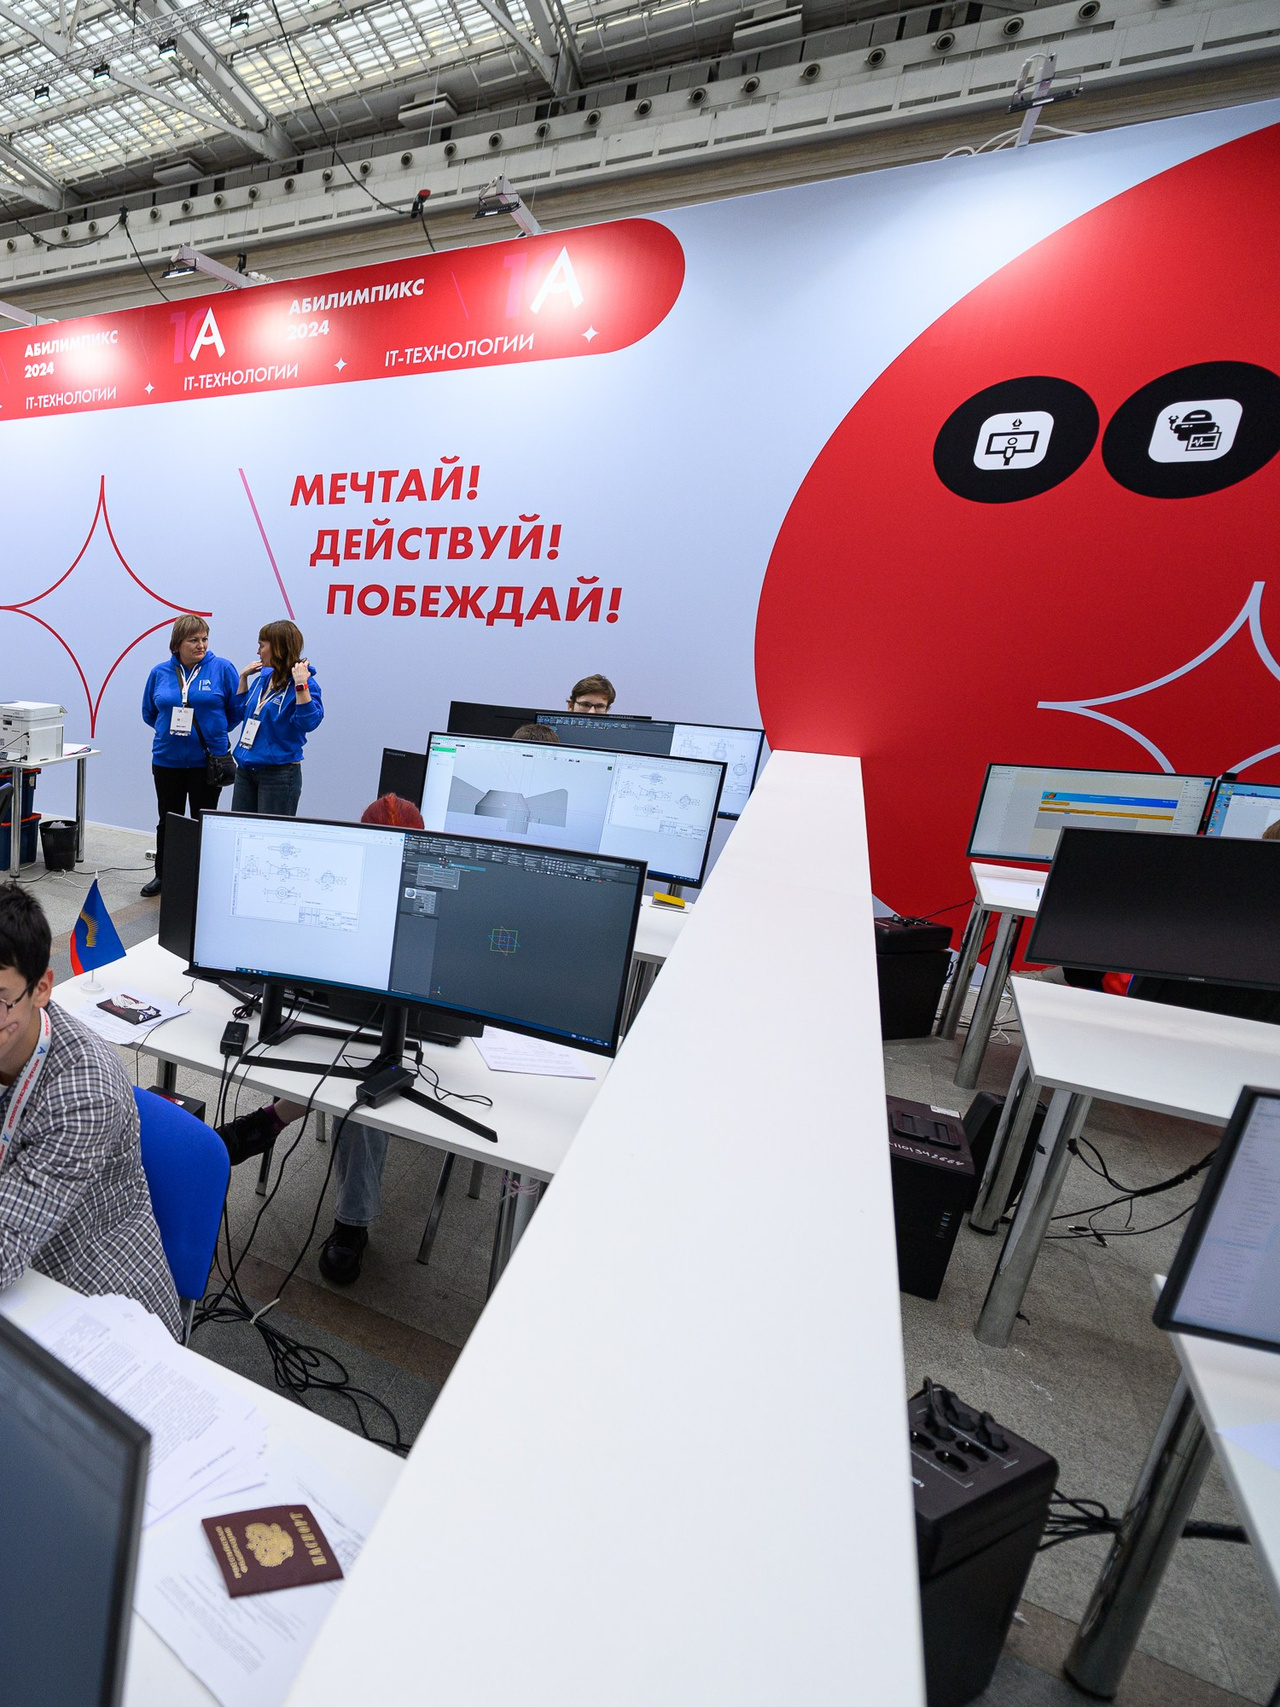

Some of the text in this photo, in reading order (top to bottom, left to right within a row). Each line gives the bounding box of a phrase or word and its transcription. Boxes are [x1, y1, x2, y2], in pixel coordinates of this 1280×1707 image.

[288, 279, 425, 315] АБИЛИМПИКС
[24, 330, 119, 358] АБИЛИМПИКС
[287, 320, 329, 341] 2024
[385, 333, 535, 367] IT-ТЕХНОЛОГИИ
[24, 362, 55, 378] 2024
[183, 363, 299, 392] IT-ТЕХНОЛОГИИ
[25, 386, 117, 410] IT-ТЕХНОЛОГИИ
[290, 455, 481, 506] МЕЧТАЙ!
[309, 513, 562, 567] ДЕЙСТВУЙ!
[326, 575, 623, 627] ПОБЕЖДАЙ!
[289, 1512, 328, 1567] ПАСПОРТ
